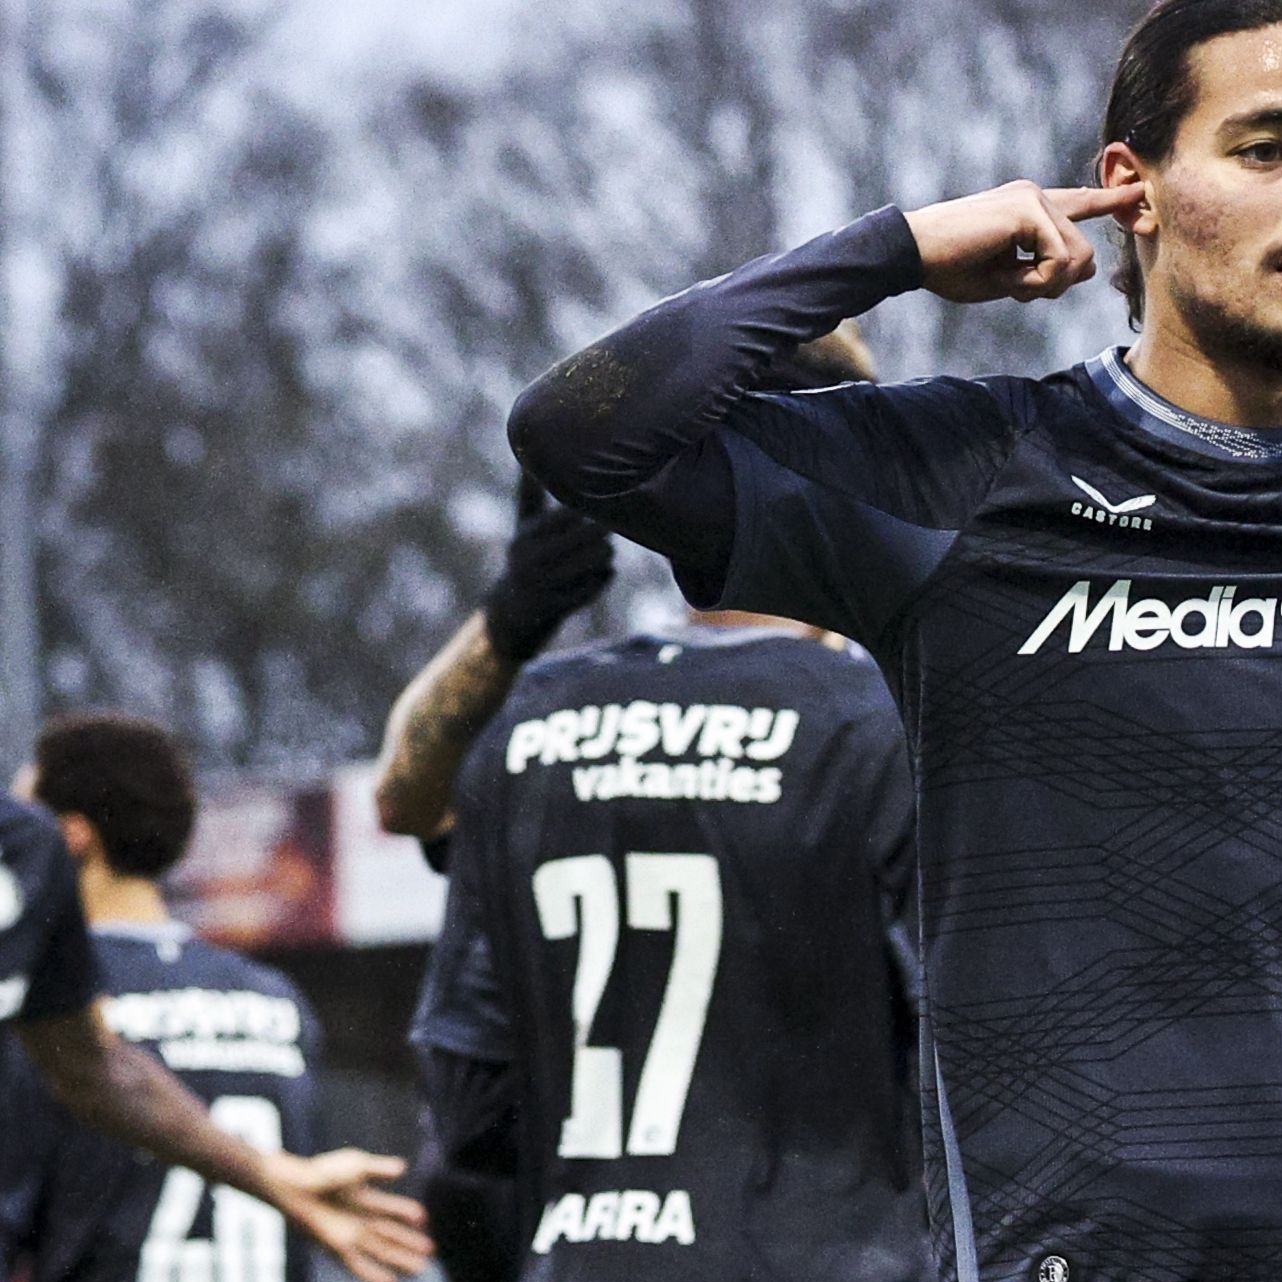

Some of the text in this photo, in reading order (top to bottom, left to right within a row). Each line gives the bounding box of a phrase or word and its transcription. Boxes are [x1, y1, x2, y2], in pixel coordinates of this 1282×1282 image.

[1071, 501, 1153, 531] CASTORE
[1017, 578, 1278, 655] Media
[506, 700, 800, 773] PRIJSVRIJ
[572, 755, 782, 803] vakanties
[531, 852, 724, 1159] 27
